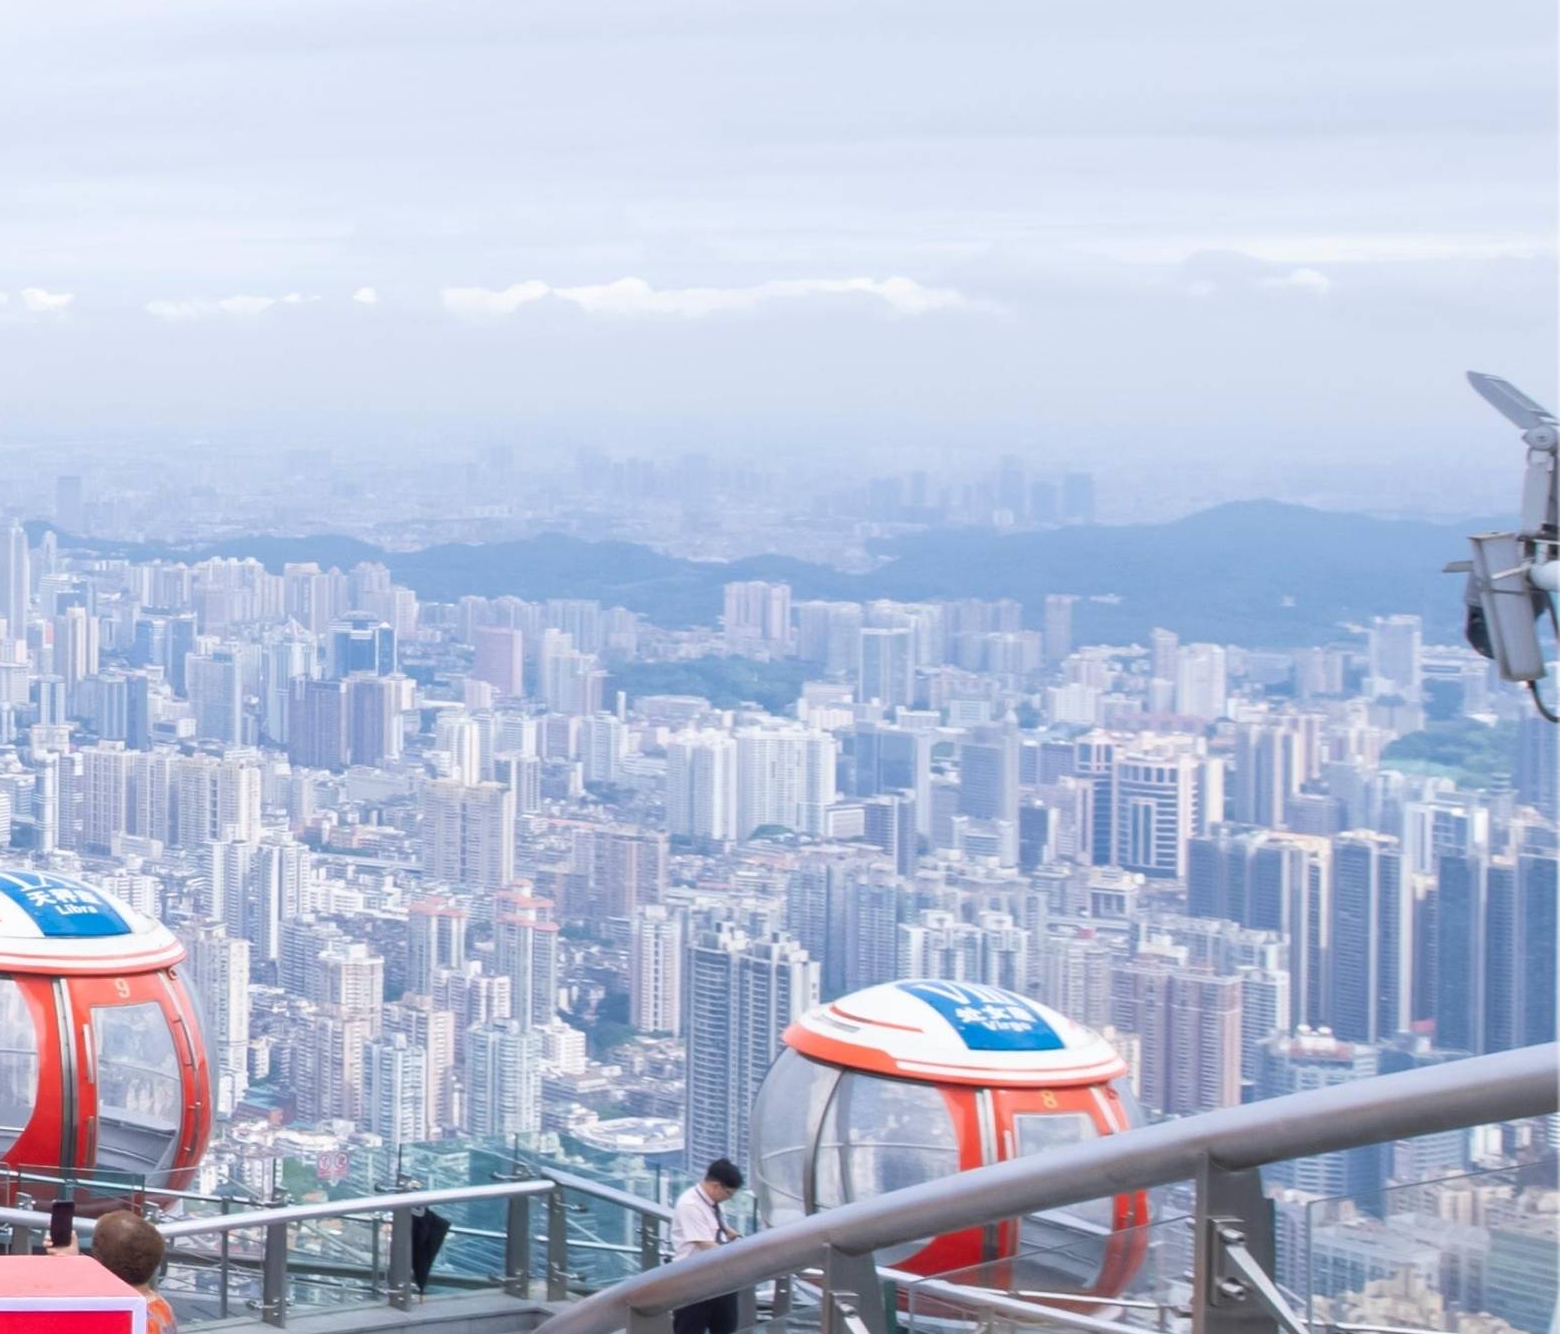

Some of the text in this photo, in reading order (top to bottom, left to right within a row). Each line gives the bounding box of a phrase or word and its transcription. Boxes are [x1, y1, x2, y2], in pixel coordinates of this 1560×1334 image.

[54, 904, 99, 915] Libra
[114, 977, 131, 999] 9
[1040, 1089, 1059, 1109] 8
